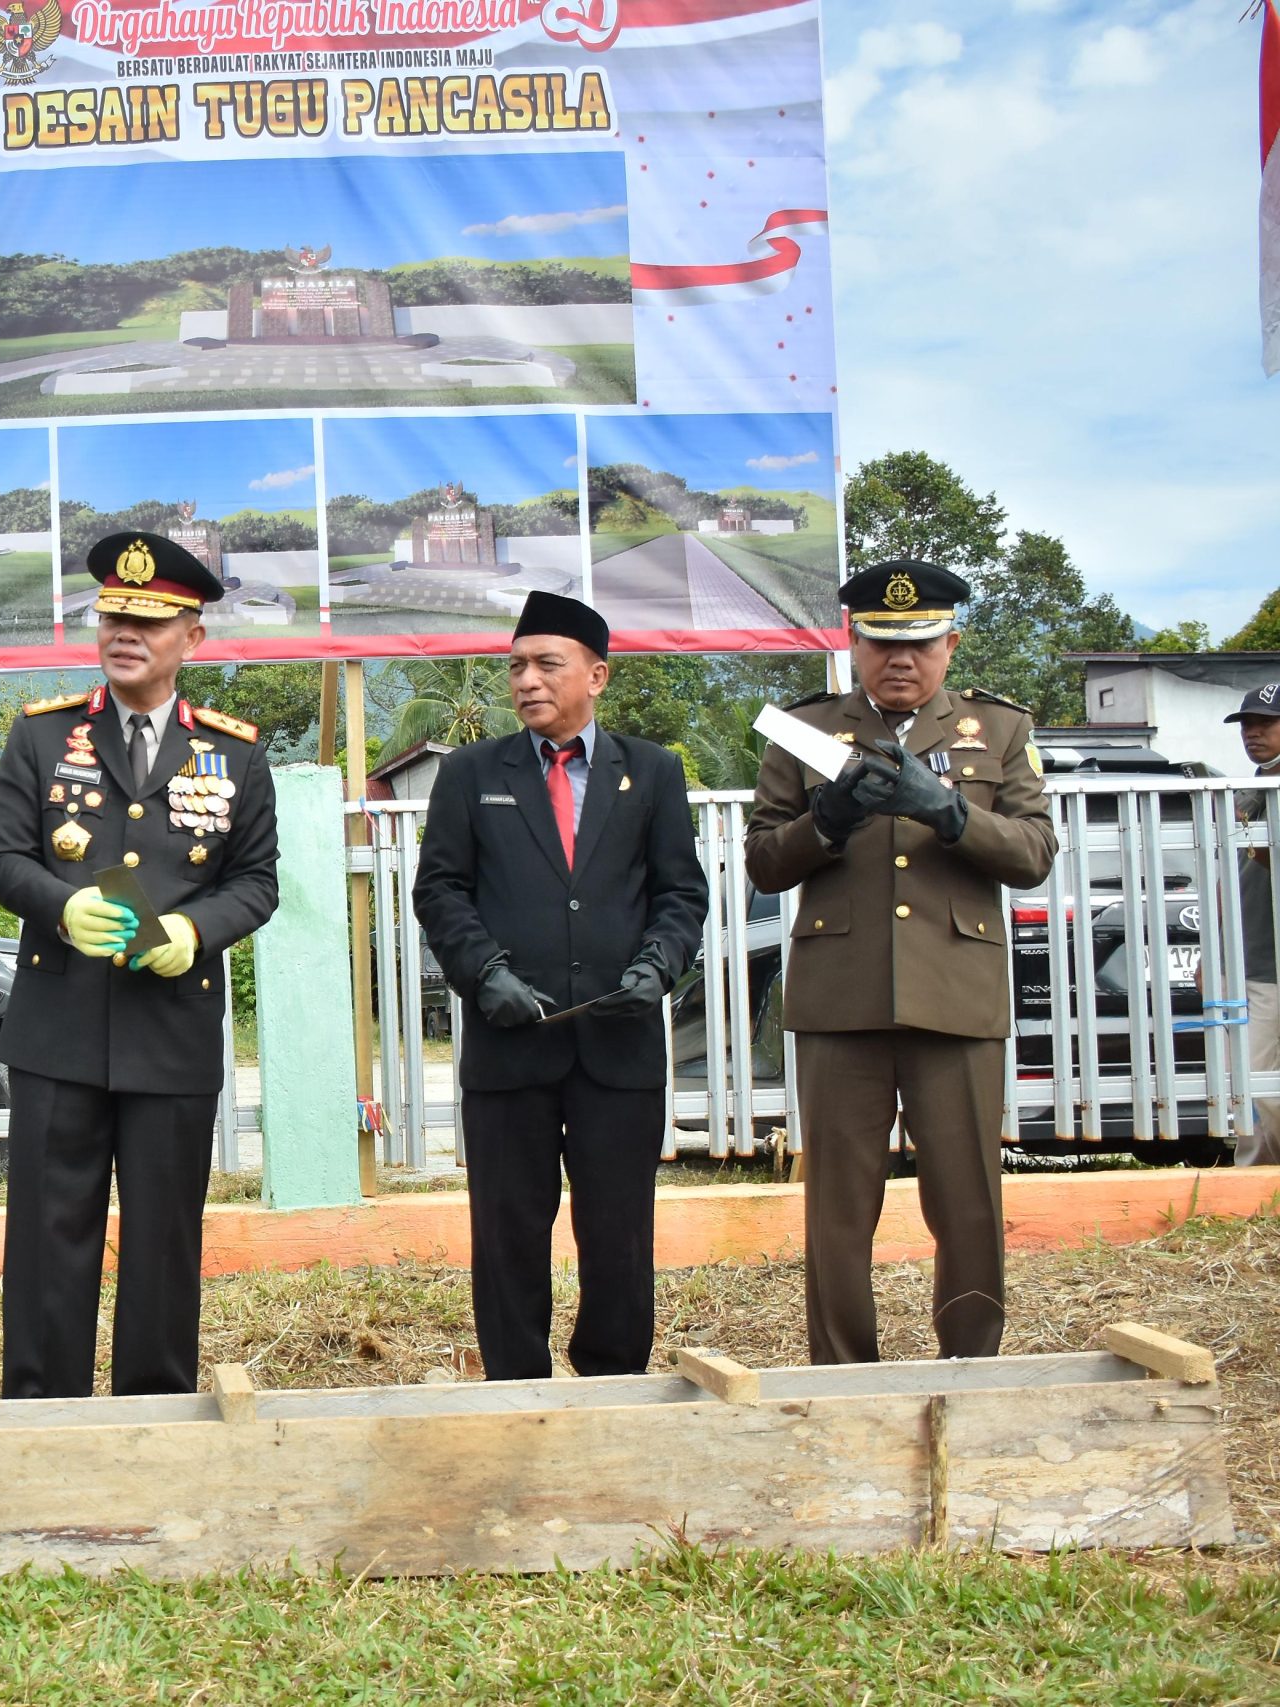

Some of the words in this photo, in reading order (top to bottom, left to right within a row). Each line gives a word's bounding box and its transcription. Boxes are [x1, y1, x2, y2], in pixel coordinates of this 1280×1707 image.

[73, 0, 236, 56] Dirgahayu
[238, 0, 369, 50] Republik
[370, 0, 520, 34] Indonesia
[117, 58, 174, 78] BERSATU
[177, 54, 250, 75] BERDAULAT
[253, 52, 303, 72] RAKYAT
[306, 51, 377, 70] SEJAHTERA
[381, 49, 452, 69] INDONESIA
[456, 48, 493, 67] MAJU
[2, 84, 180, 150] DESAIN
[194, 79, 328, 139] TUGU
[342, 73, 611, 136] PANCASILA
